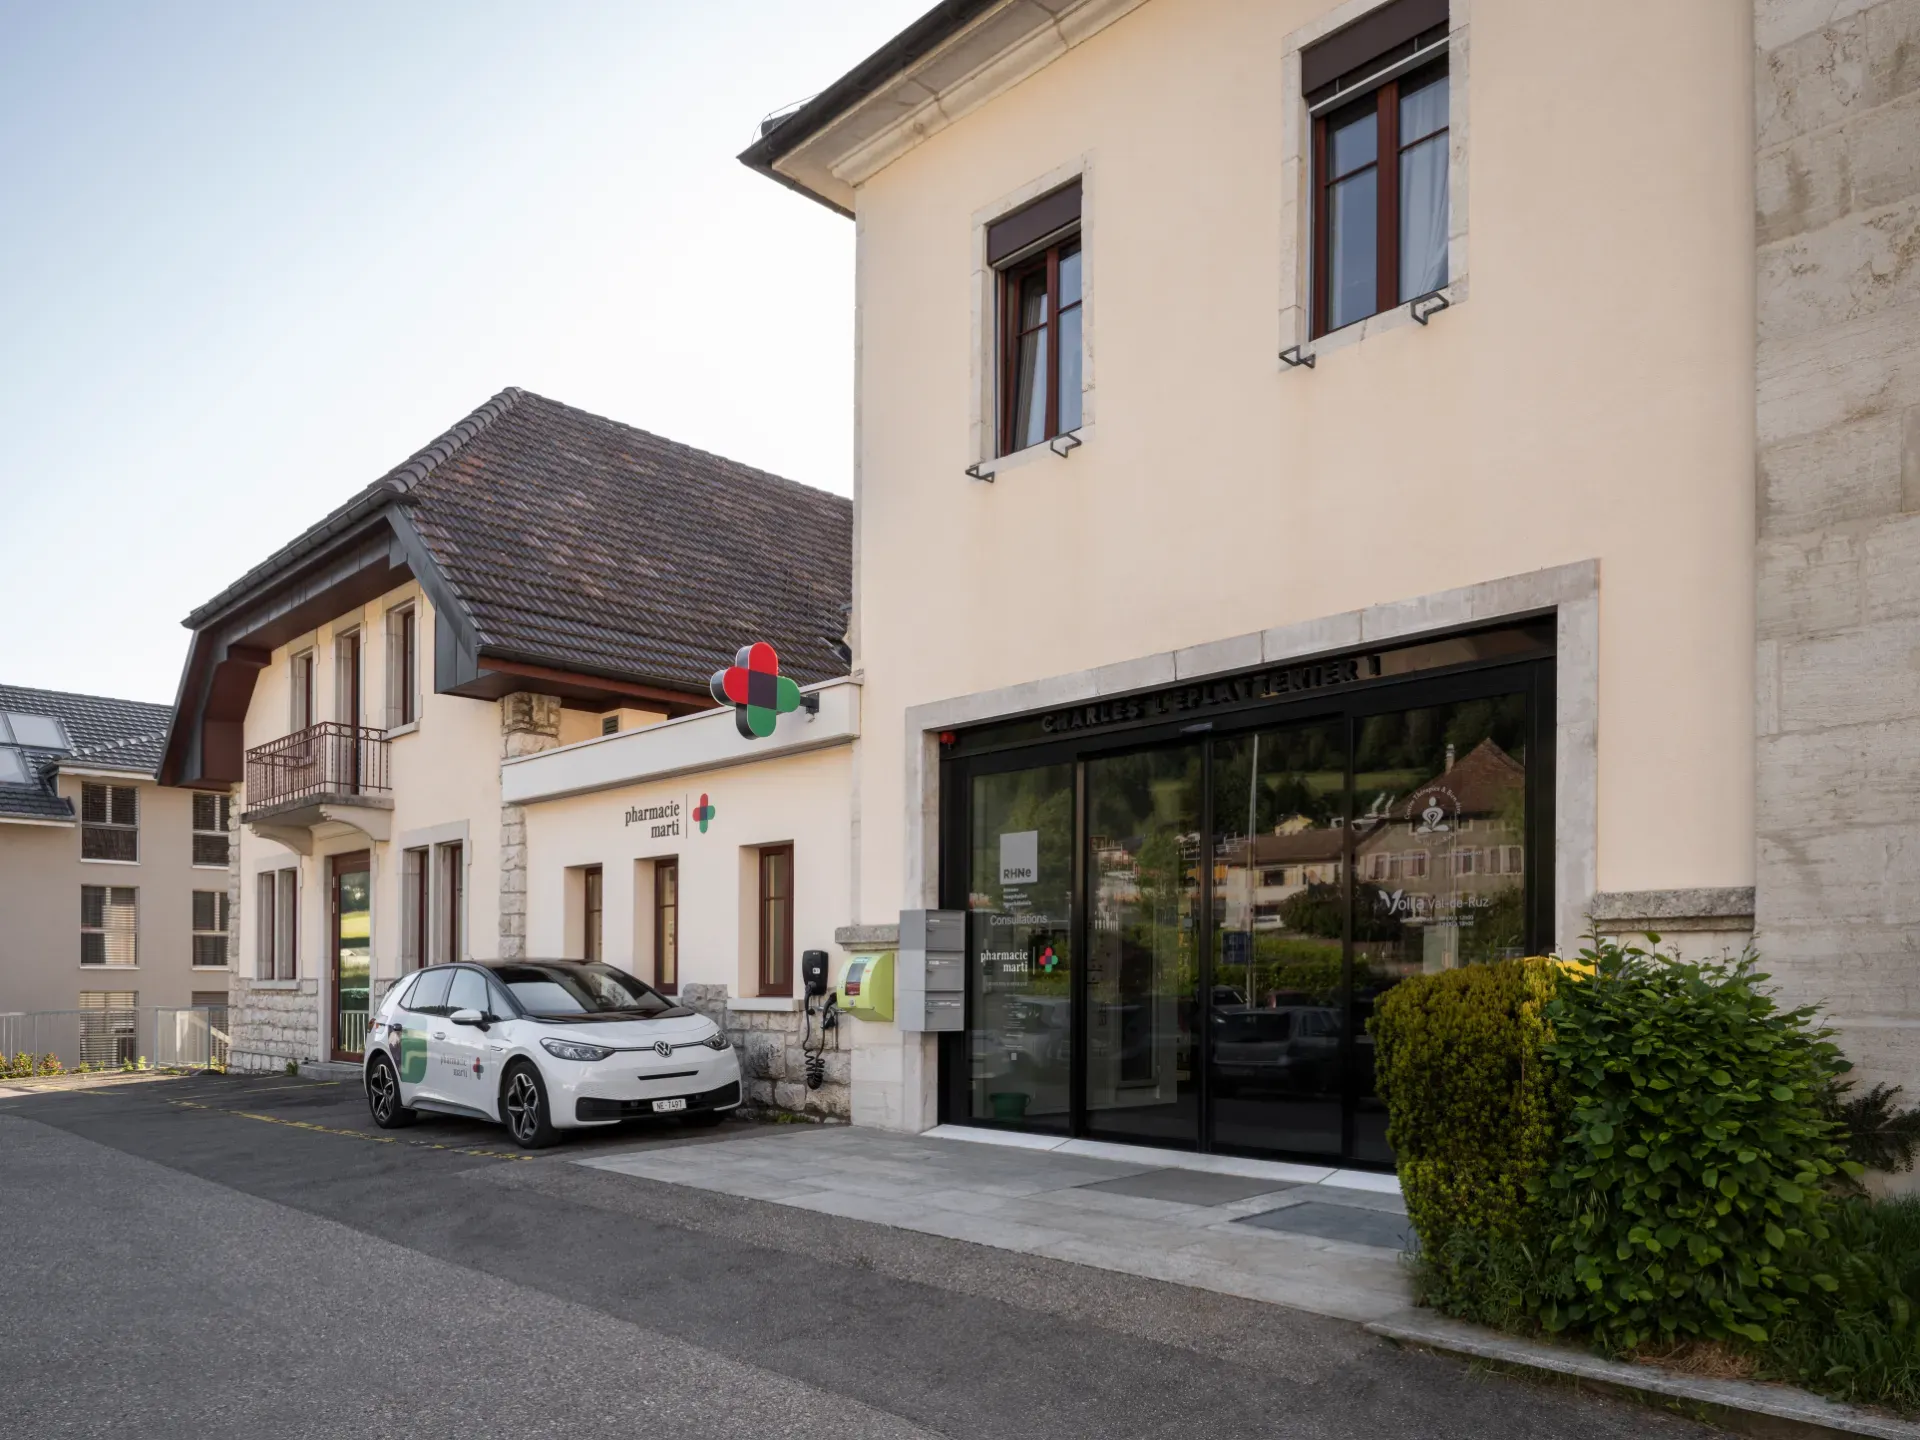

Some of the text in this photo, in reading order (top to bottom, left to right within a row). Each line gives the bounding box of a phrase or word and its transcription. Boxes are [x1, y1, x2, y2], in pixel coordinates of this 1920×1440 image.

[1041, 700, 1142, 733] CHARLES
[625, 800, 680, 827] pharmacie
[651, 819, 680, 838] marti
[1003, 867, 1032, 880] RHNe
[1428, 896, 1490, 910] Val-de-Ruz
[989, 914, 1048, 926] Consultations
[980, 949, 1029, 963] pharmacie
[1003, 961, 1029, 973] marti
